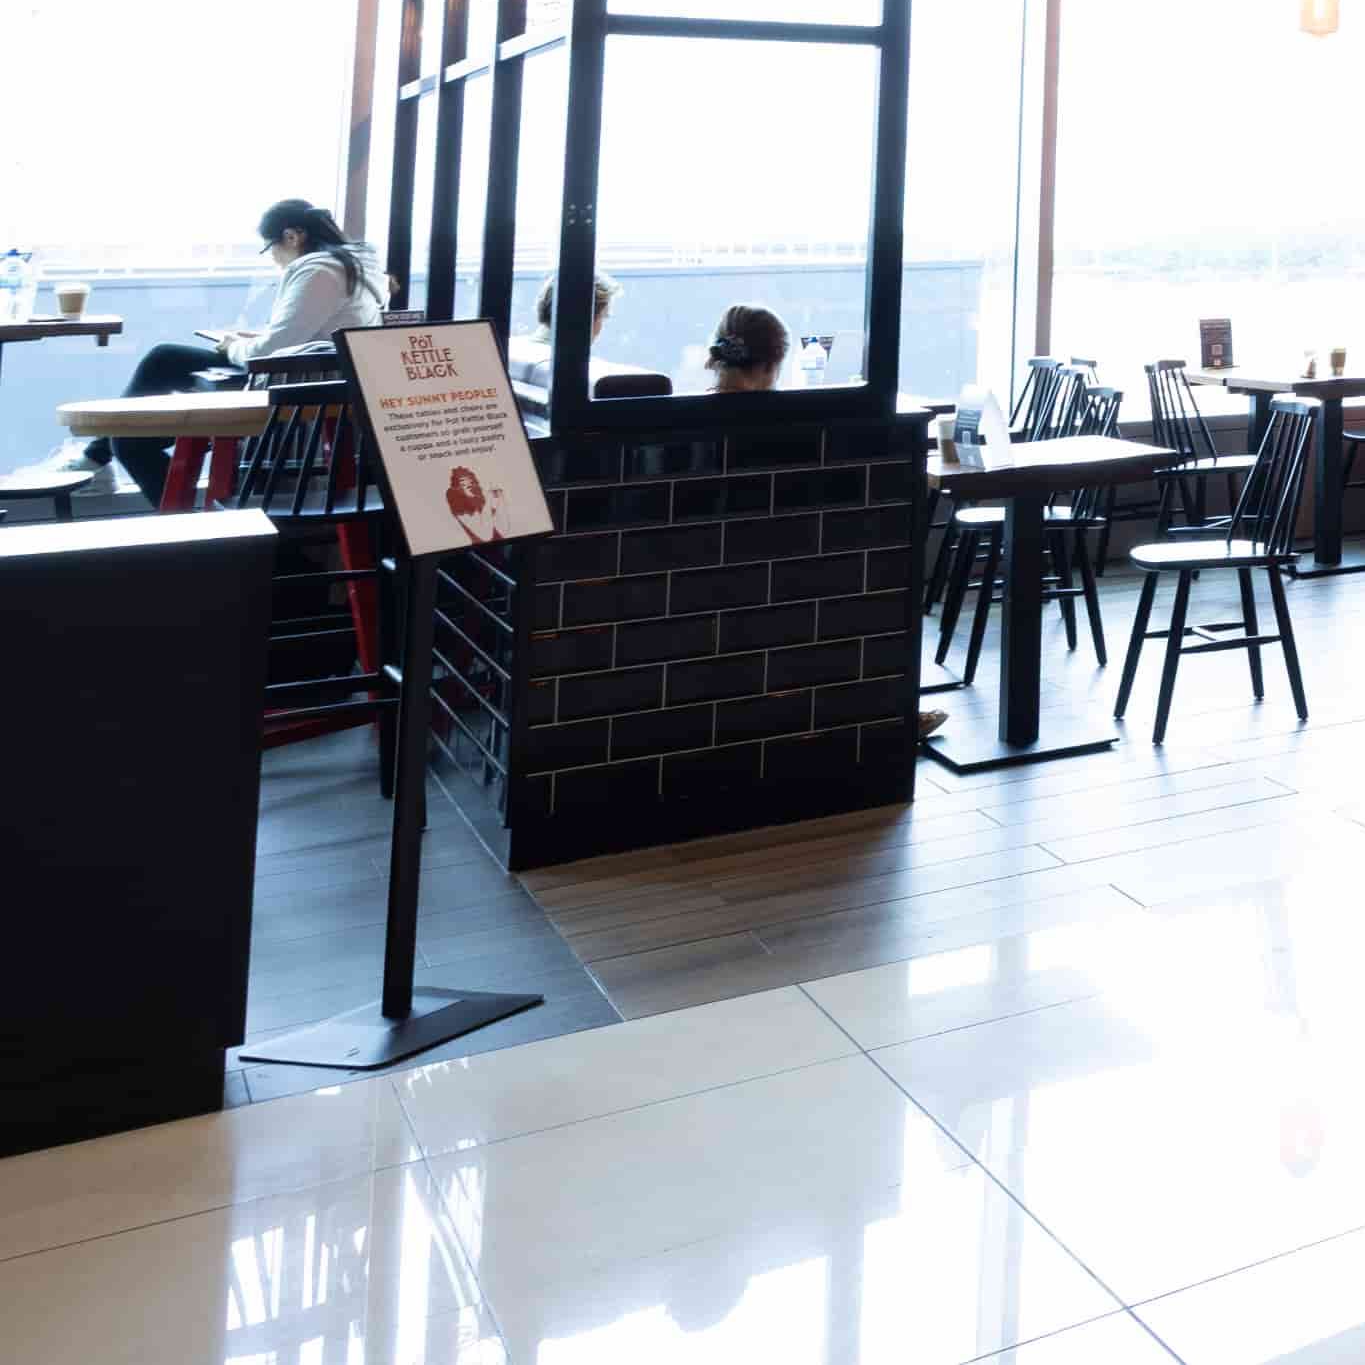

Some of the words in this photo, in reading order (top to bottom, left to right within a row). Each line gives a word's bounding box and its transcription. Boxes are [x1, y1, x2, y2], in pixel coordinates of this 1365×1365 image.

[400, 348, 455, 365] KETTLE
[405, 363, 459, 380] BLACK
[380, 396, 403, 409] HEY
[407, 392, 447, 407] SUNNY
[448, 387, 497, 402] PEOPLE!
